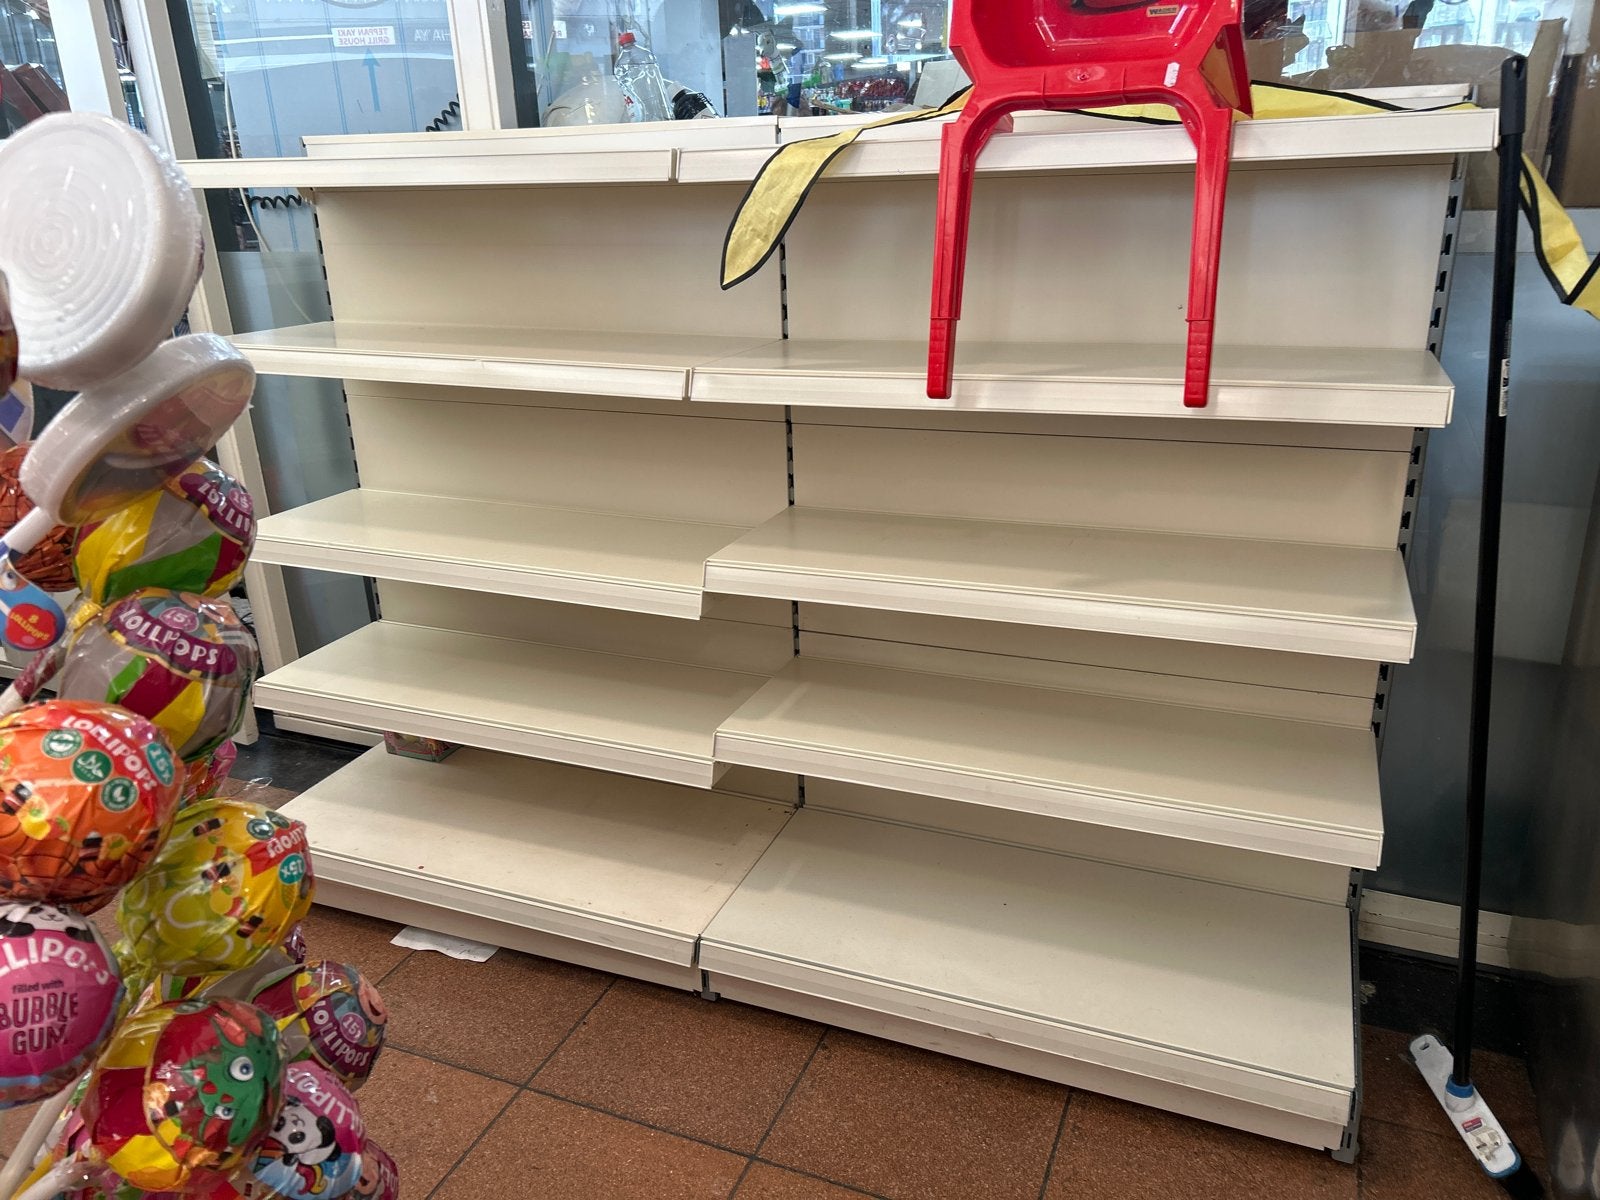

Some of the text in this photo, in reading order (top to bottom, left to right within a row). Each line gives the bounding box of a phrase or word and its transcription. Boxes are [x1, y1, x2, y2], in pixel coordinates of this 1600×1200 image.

[119, 608, 219, 665] LOLLIPOPS
[281, 859, 303, 879] 15x
[0, 992, 78, 1030] BUBBLE
[12, 1024, 69, 1056] GUM
[311, 1000, 369, 1067] LOLLIPOPS
